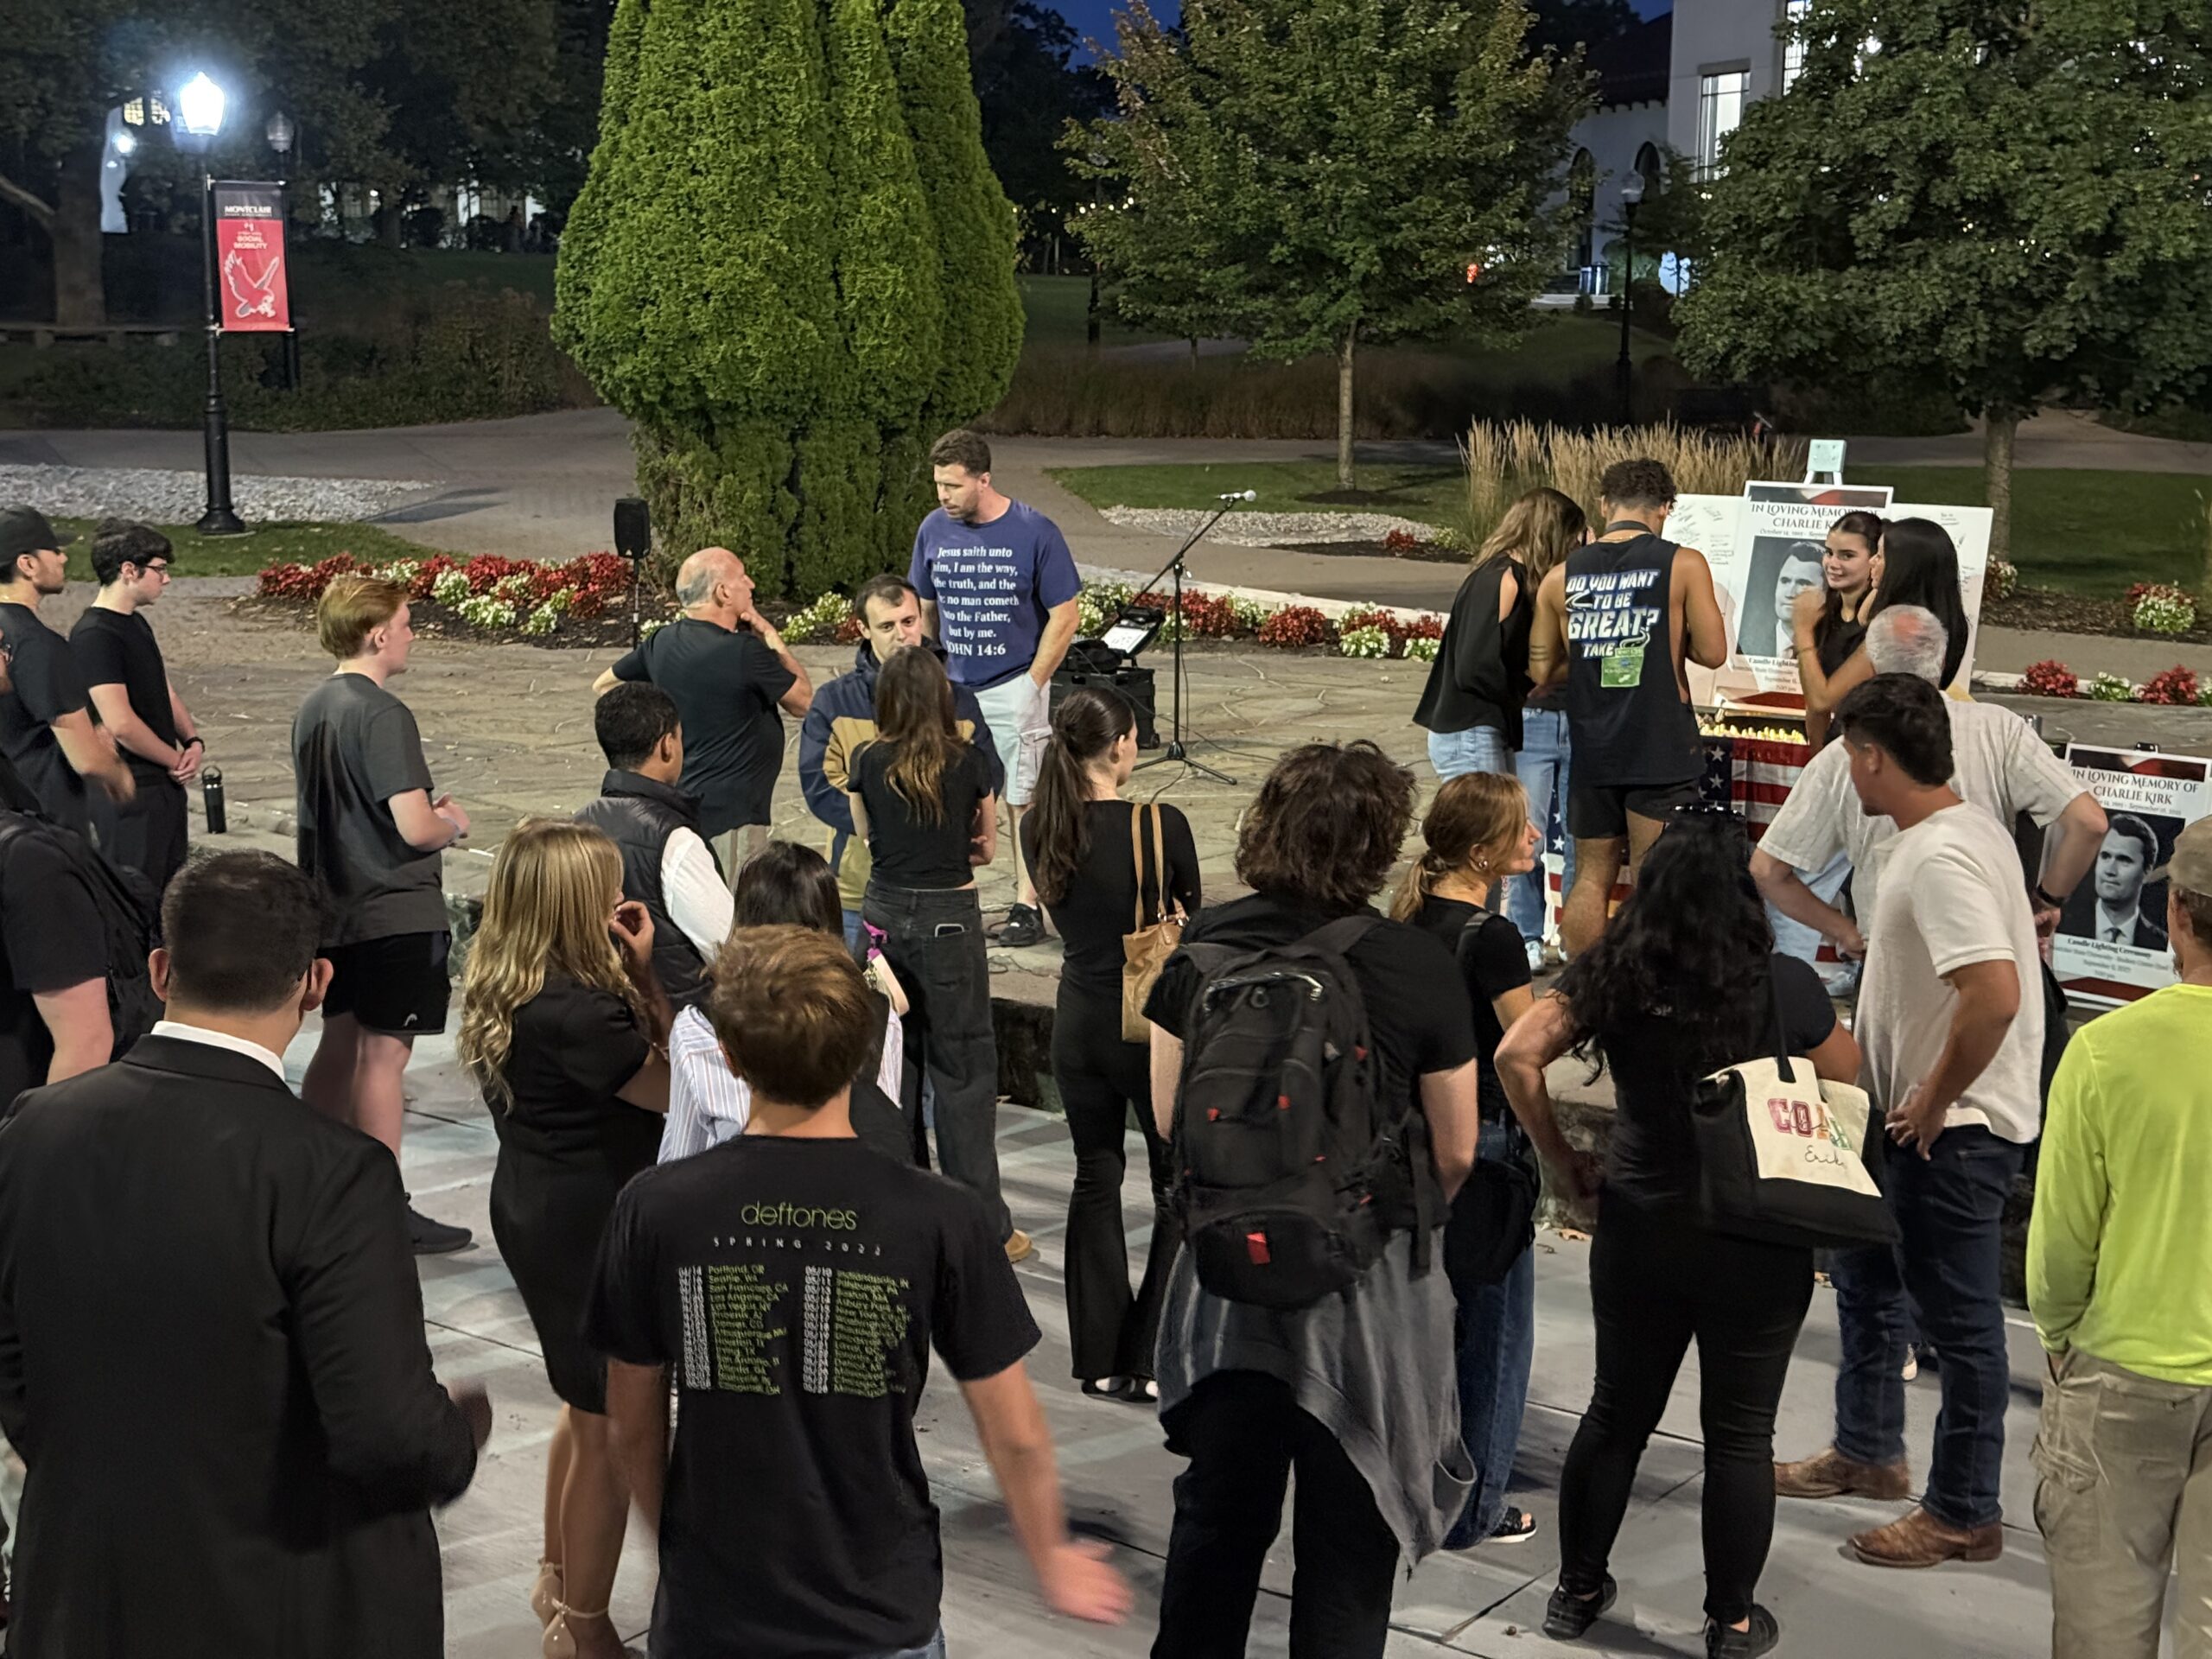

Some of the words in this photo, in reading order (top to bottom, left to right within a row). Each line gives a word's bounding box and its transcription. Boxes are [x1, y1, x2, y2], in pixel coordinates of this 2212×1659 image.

[224, 206, 272, 214] MONTCLAIR
[1751, 504, 1764, 513] IN
[1772, 518, 1823, 530] CHARLIE
[938, 546, 962, 558] Jesus
[963, 545, 987, 557] saith
[988, 547, 1013, 557] unto
[954, 562, 958, 573] I
[960, 564, 975, 573] am
[977, 562, 993, 573] the
[995, 563, 1018, 576] way,
[949, 577, 976, 591] truth,
[978, 578, 996, 589] and
[999, 578, 1016, 590] the
[1566, 575, 1587, 593] DO
[1589, 574, 1618, 591] YOU
[1618, 571, 1659, 590] WANT
[947, 595, 959, 605] no
[961, 596, 982, 606] man
[983, 594, 1020, 607] cometh
[1592, 594, 1612, 610] TO
[1614, 591, 1633, 609] BE
[957, 610, 972, 622] the
[974, 610, 1011, 623] Father,
[1567, 608, 1660, 640] GREAT?
[963, 626, 976, 640] by
[977, 628, 996, 638] me.
[977, 643, 1007, 657] 14:6
[1583, 642, 1616, 658] TAKE
[2087, 768, 2129, 785] LOVING
[2132, 775, 2182, 792] MEMORY
[2183, 781, 2200, 794] OF
[2093, 785, 2143, 802] CHARLIE
[2145, 791, 2173, 805] KIRK
[2068, 938, 2090, 948] Candle
[2091, 942, 2119, 955] Lighting
[2120, 947, 2152, 959] Ceremony
[741, 1201, 859, 1230] deftones
[713, 1236, 803, 1249] SPRING
[774, 1283, 790, 1294] CA
